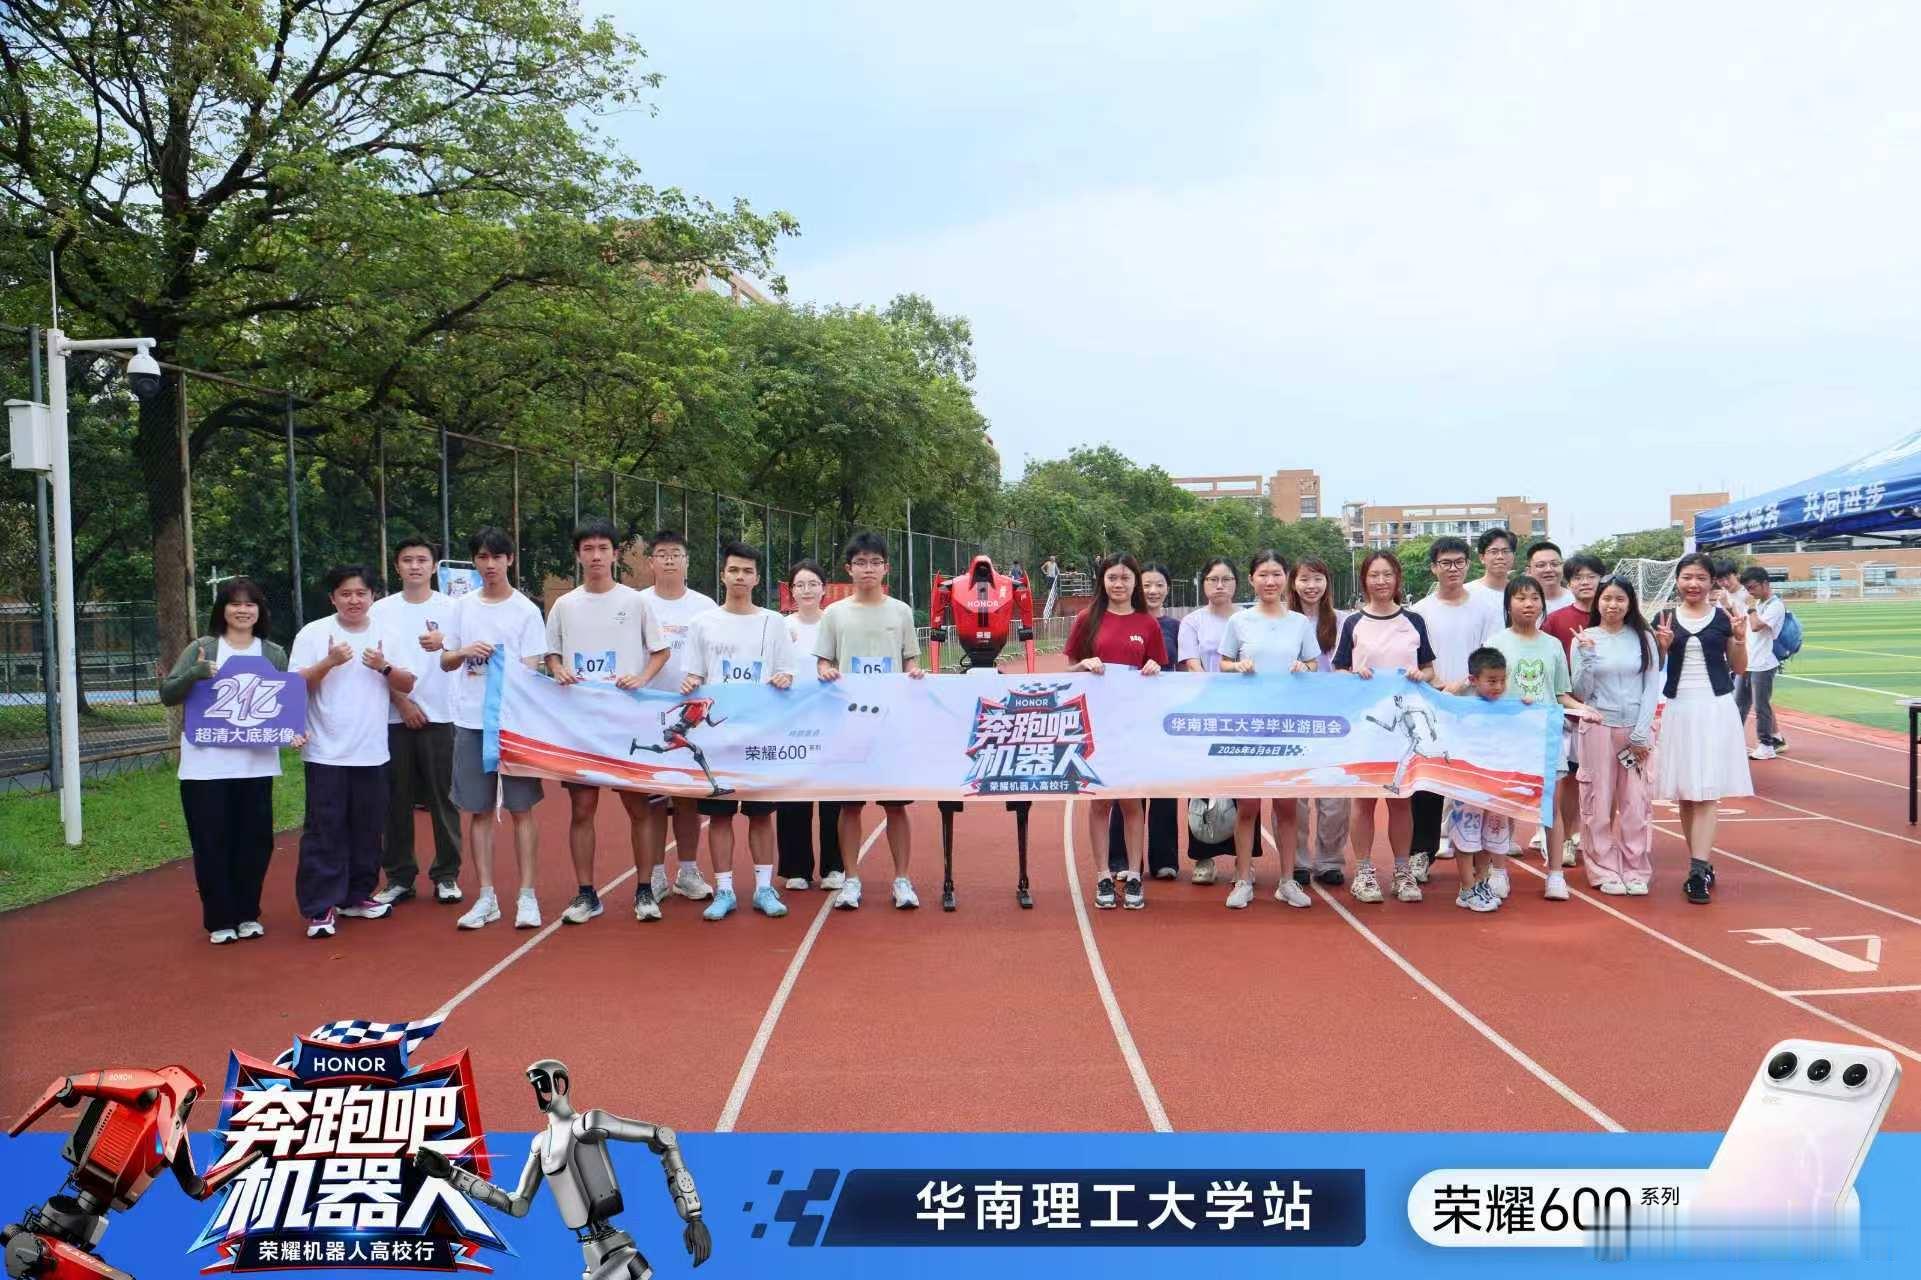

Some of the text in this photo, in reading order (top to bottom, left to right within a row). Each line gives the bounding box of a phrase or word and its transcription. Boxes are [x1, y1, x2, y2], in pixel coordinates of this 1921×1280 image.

[1803, 480, 1886, 522] 共同进步
[967, 600, 999, 608] HONOR
[586, 659, 606, 673] 07
[733, 667, 752, 680] 06
[203, 676, 287, 721] 2亿
[1015, 698, 1049, 707] HONOR
[970, 710, 1089, 747] 奔跑吧
[1171, 717, 1342, 735] 华南理工大学毕业游园会
[195, 727, 295, 744] 超清大底影像
[745, 744, 807, 761] 荣耀600
[1217, 745, 1281, 756] 2026年6月6日
[970, 744, 1098, 780] 机器人
[989, 780, 1070, 792] 荣耀机器人高校行
[1463, 812, 1481, 830] 23
